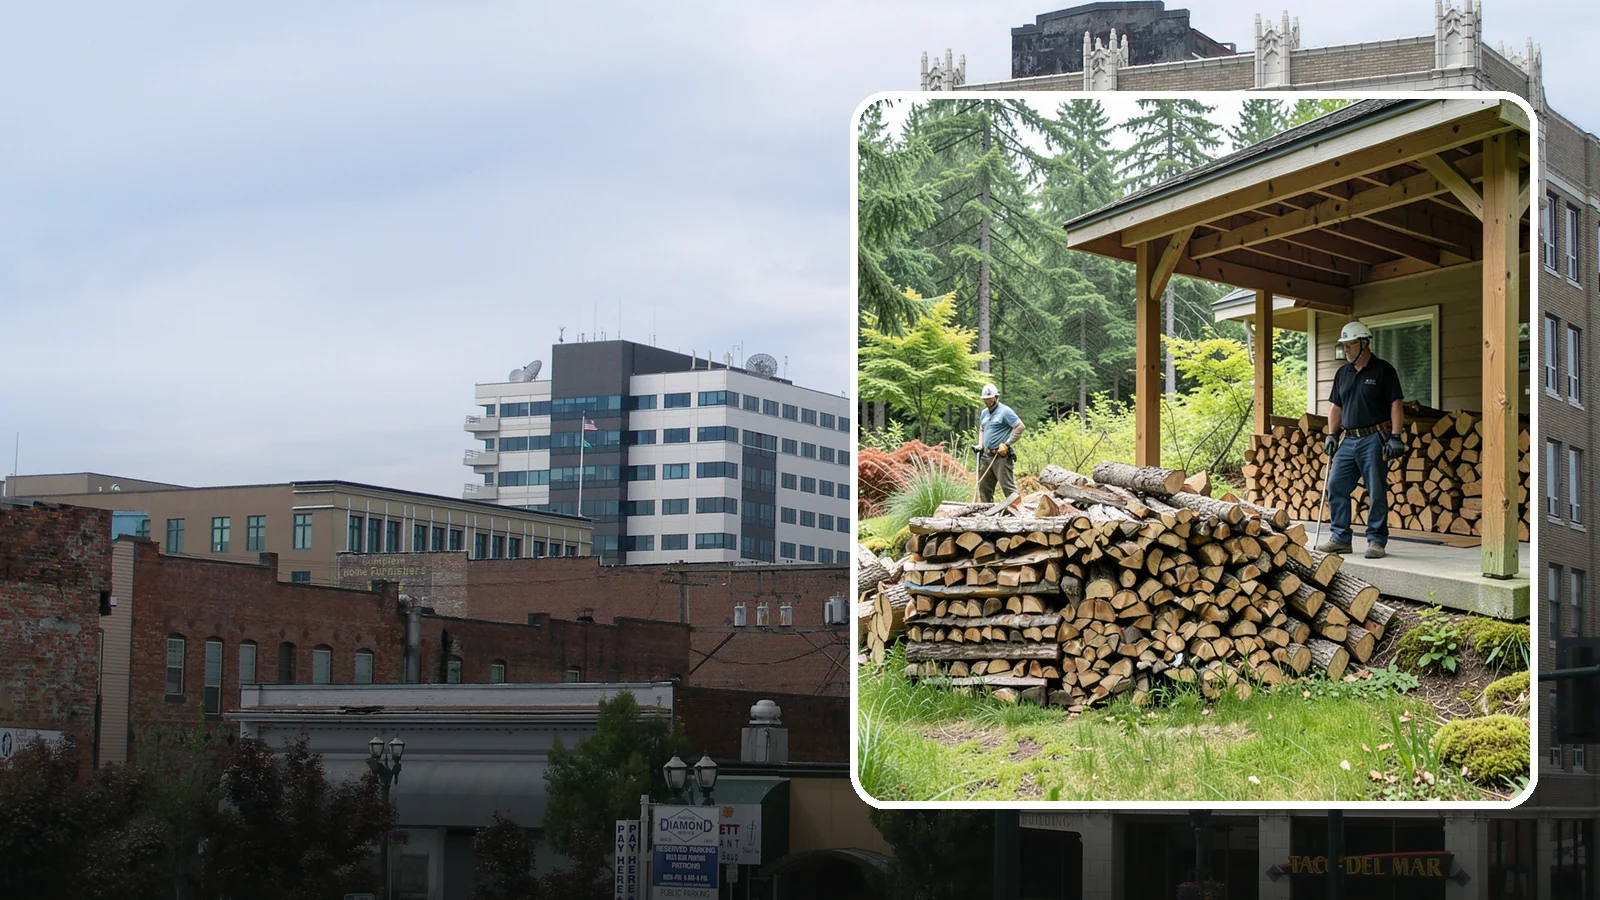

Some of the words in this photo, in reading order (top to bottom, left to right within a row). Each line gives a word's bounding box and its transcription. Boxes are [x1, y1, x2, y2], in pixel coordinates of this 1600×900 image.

[371, 567, 427, 577] Furnishers
[660, 818, 713, 832] DIAMOND
[1021, 815, 1070, 828] BUILDING
[617, 825, 625, 852] PAY
[628, 825, 637, 852] PAY
[655, 845, 688, 853] RESERVED
[689, 846, 716, 854] PARKING
[671, 862, 701, 870] PATRONS
[1345, 856, 1384, 876] DEL
[1392, 857, 1442, 877] MAR
[616, 856, 625, 893] HERE
[627, 856, 637, 893] HERE
[660, 888, 682, 897] PUBLIC
[683, 889, 710, 898] PARKING
